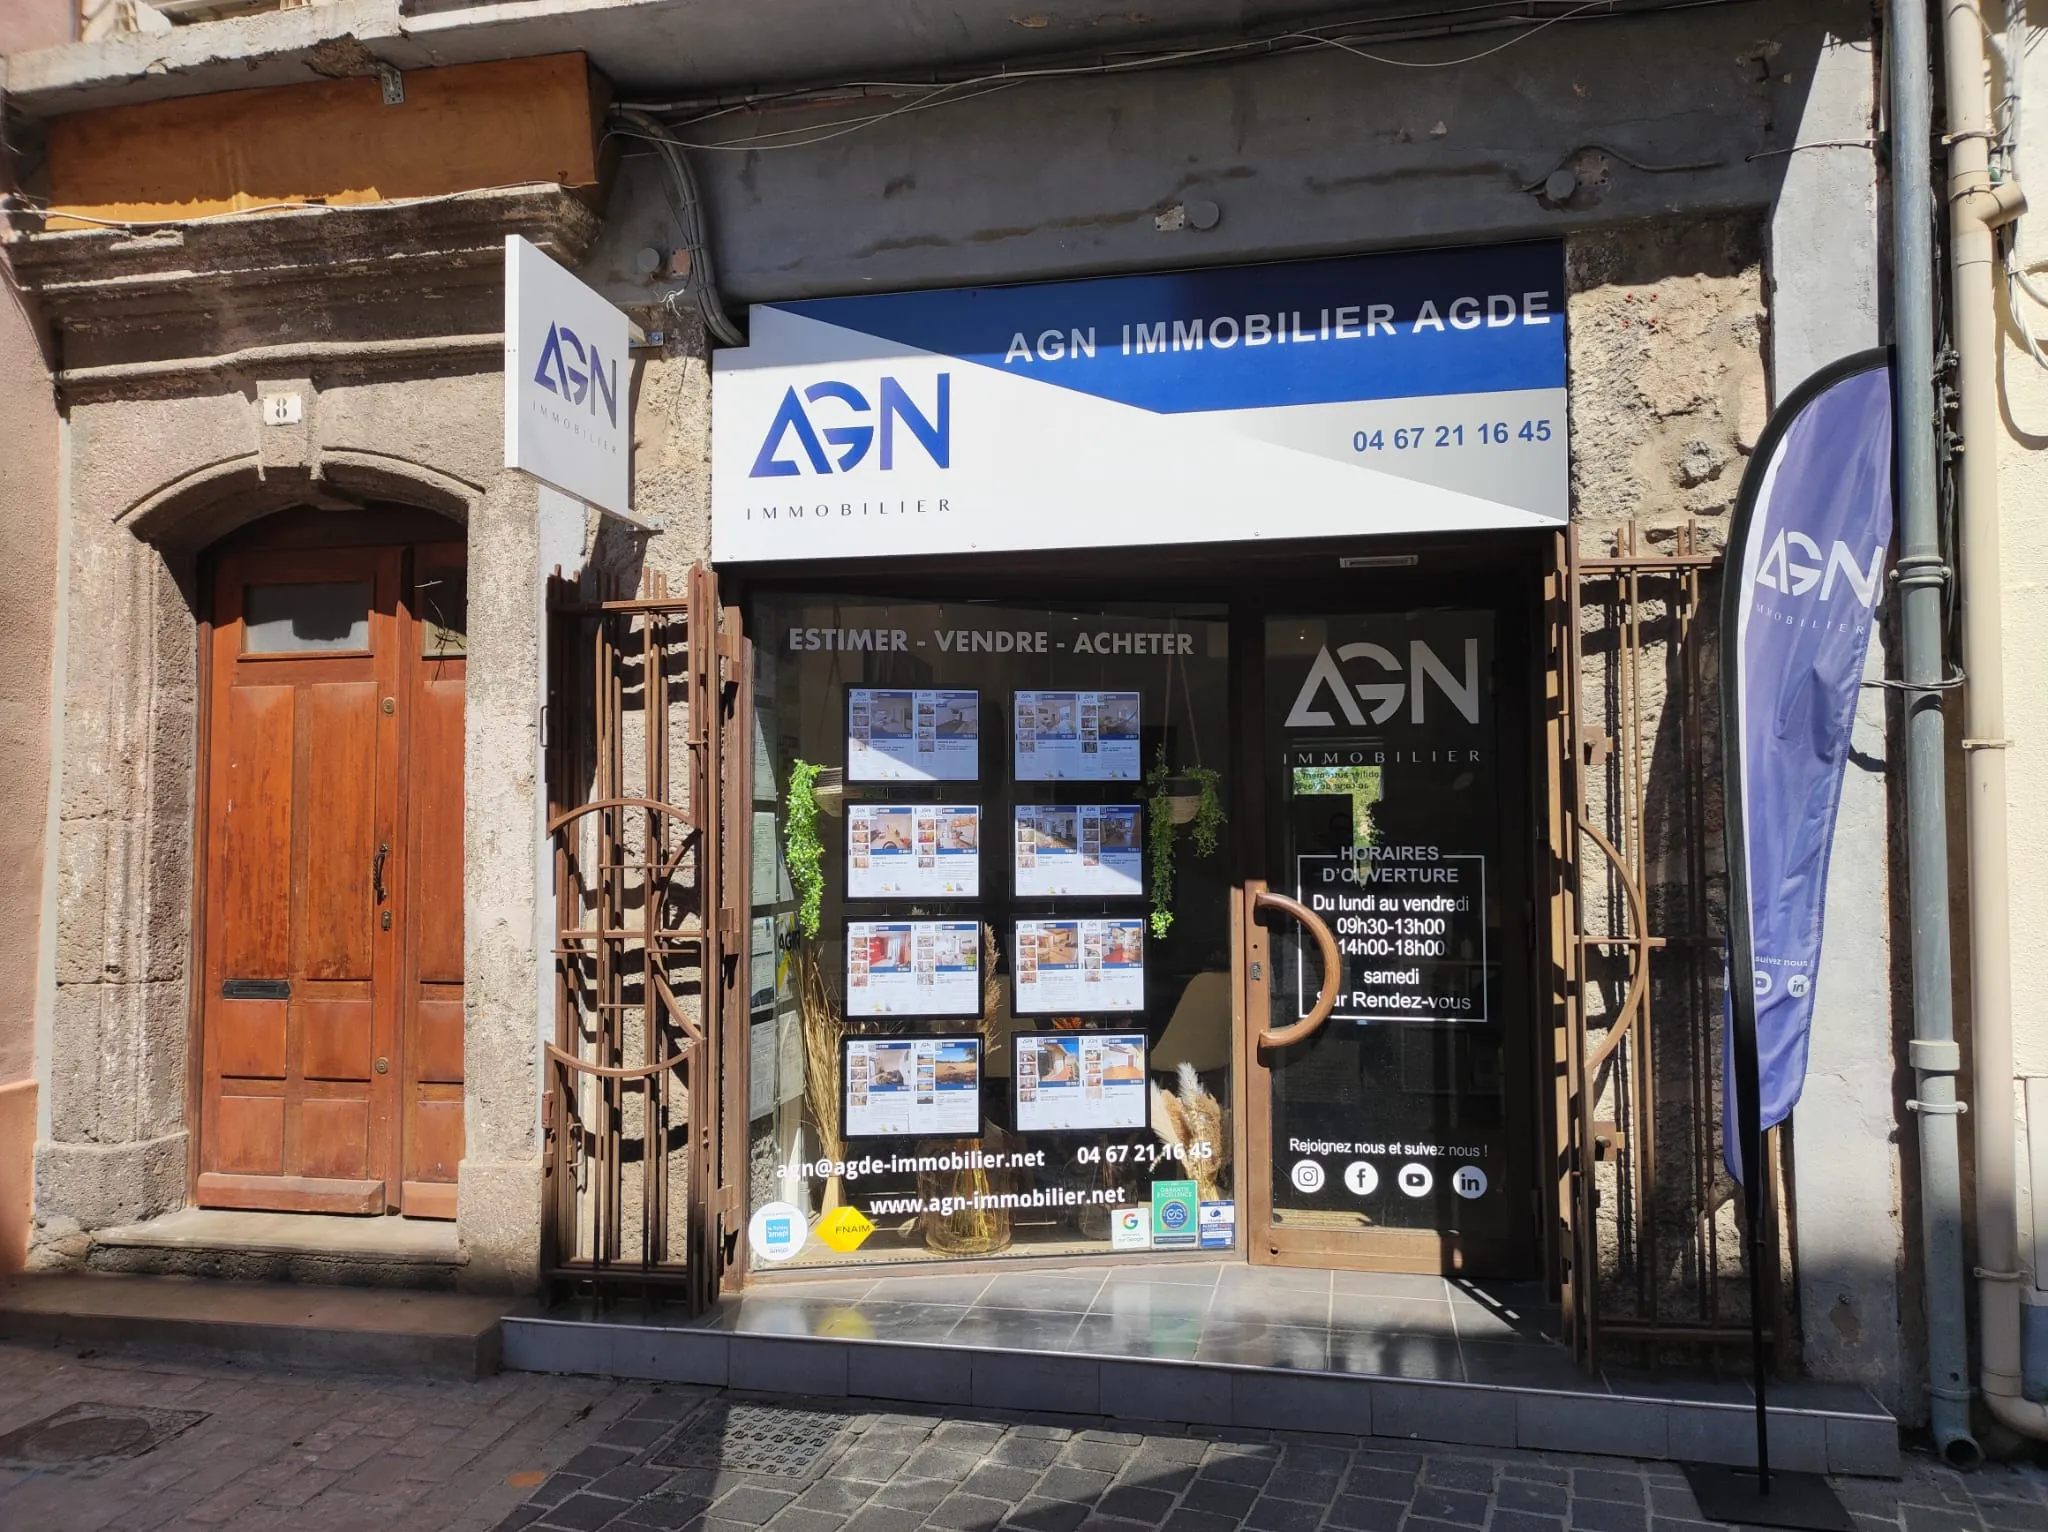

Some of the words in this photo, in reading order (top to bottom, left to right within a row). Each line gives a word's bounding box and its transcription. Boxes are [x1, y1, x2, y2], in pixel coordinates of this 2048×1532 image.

[1004, 327, 1096, 364] AGN
[1122, 304, 1397, 356] IMMOBILIER
[1411, 291, 1551, 333] AGDE
[533, 320, 617, 430] AGN
[276, 398, 287, 418] 8
[532, 400, 617, 455] IMMOBILIER
[748, 373, 950, 479] AGN
[1353, 430, 1384, 452] 04
[1393, 427, 1425, 450] 67
[1436, 425, 1465, 448] 21
[1477, 423, 1509, 445] 16
[1518, 420, 1551, 442] 45
[746, 499, 951, 521] IMMOBILIER
[1756, 527, 1883, 608] AGN
[1757, 603, 1864, 634] MMOBILIER
[789, 628, 908, 651] ESTIMER
[934, 630, 1048, 653] VENDRE
[1073, 631, 1194, 655] ACHETER
[1284, 638, 1479, 727] AGN
[1283, 750, 1481, 765] IMMOBILIER
[1341, 846, 1439, 861] HORAIRES
[1323, 867, 1459, 883] D'OUVERTURE
[1313, 894, 1334, 911] Du
[1339, 894, 1375, 911] lundi
[1379, 898, 1399, 912] au
[1402, 895, 1469, 912] vendredi
[1337, 918, 1445, 935] 09h30-13h00
[1337, 938, 1445, 956] 14h00-18h00
[1783, 959, 1808, 967] nous
[1363, 968, 1420, 985] samedi
[1352, 991, 1472, 1010] Rendez-vous
[1077, 1147, 1100, 1164] 04
[1105, 1145, 1129, 1163] 67
[1134, 1144, 1155, 1162] 21
[1163, 1143, 1185, 1161] 16
[1189, 1142, 1212, 1159] 45
[1289, 1138, 1351, 1155] Rejoignez
[1355, 1142, 1386, 1154] nous
[1389, 1142, 1401, 1154] et
[1404, 1143, 1445, 1156] suivez
[1449, 1145, 1480, 1157] nous
[777, 1149, 1045, 1180] agn@agde-immobilier.net
[869, 1186, 1126, 1215] www.agn-immobilier.net
[835, 1224, 870, 1235] FNAIM
